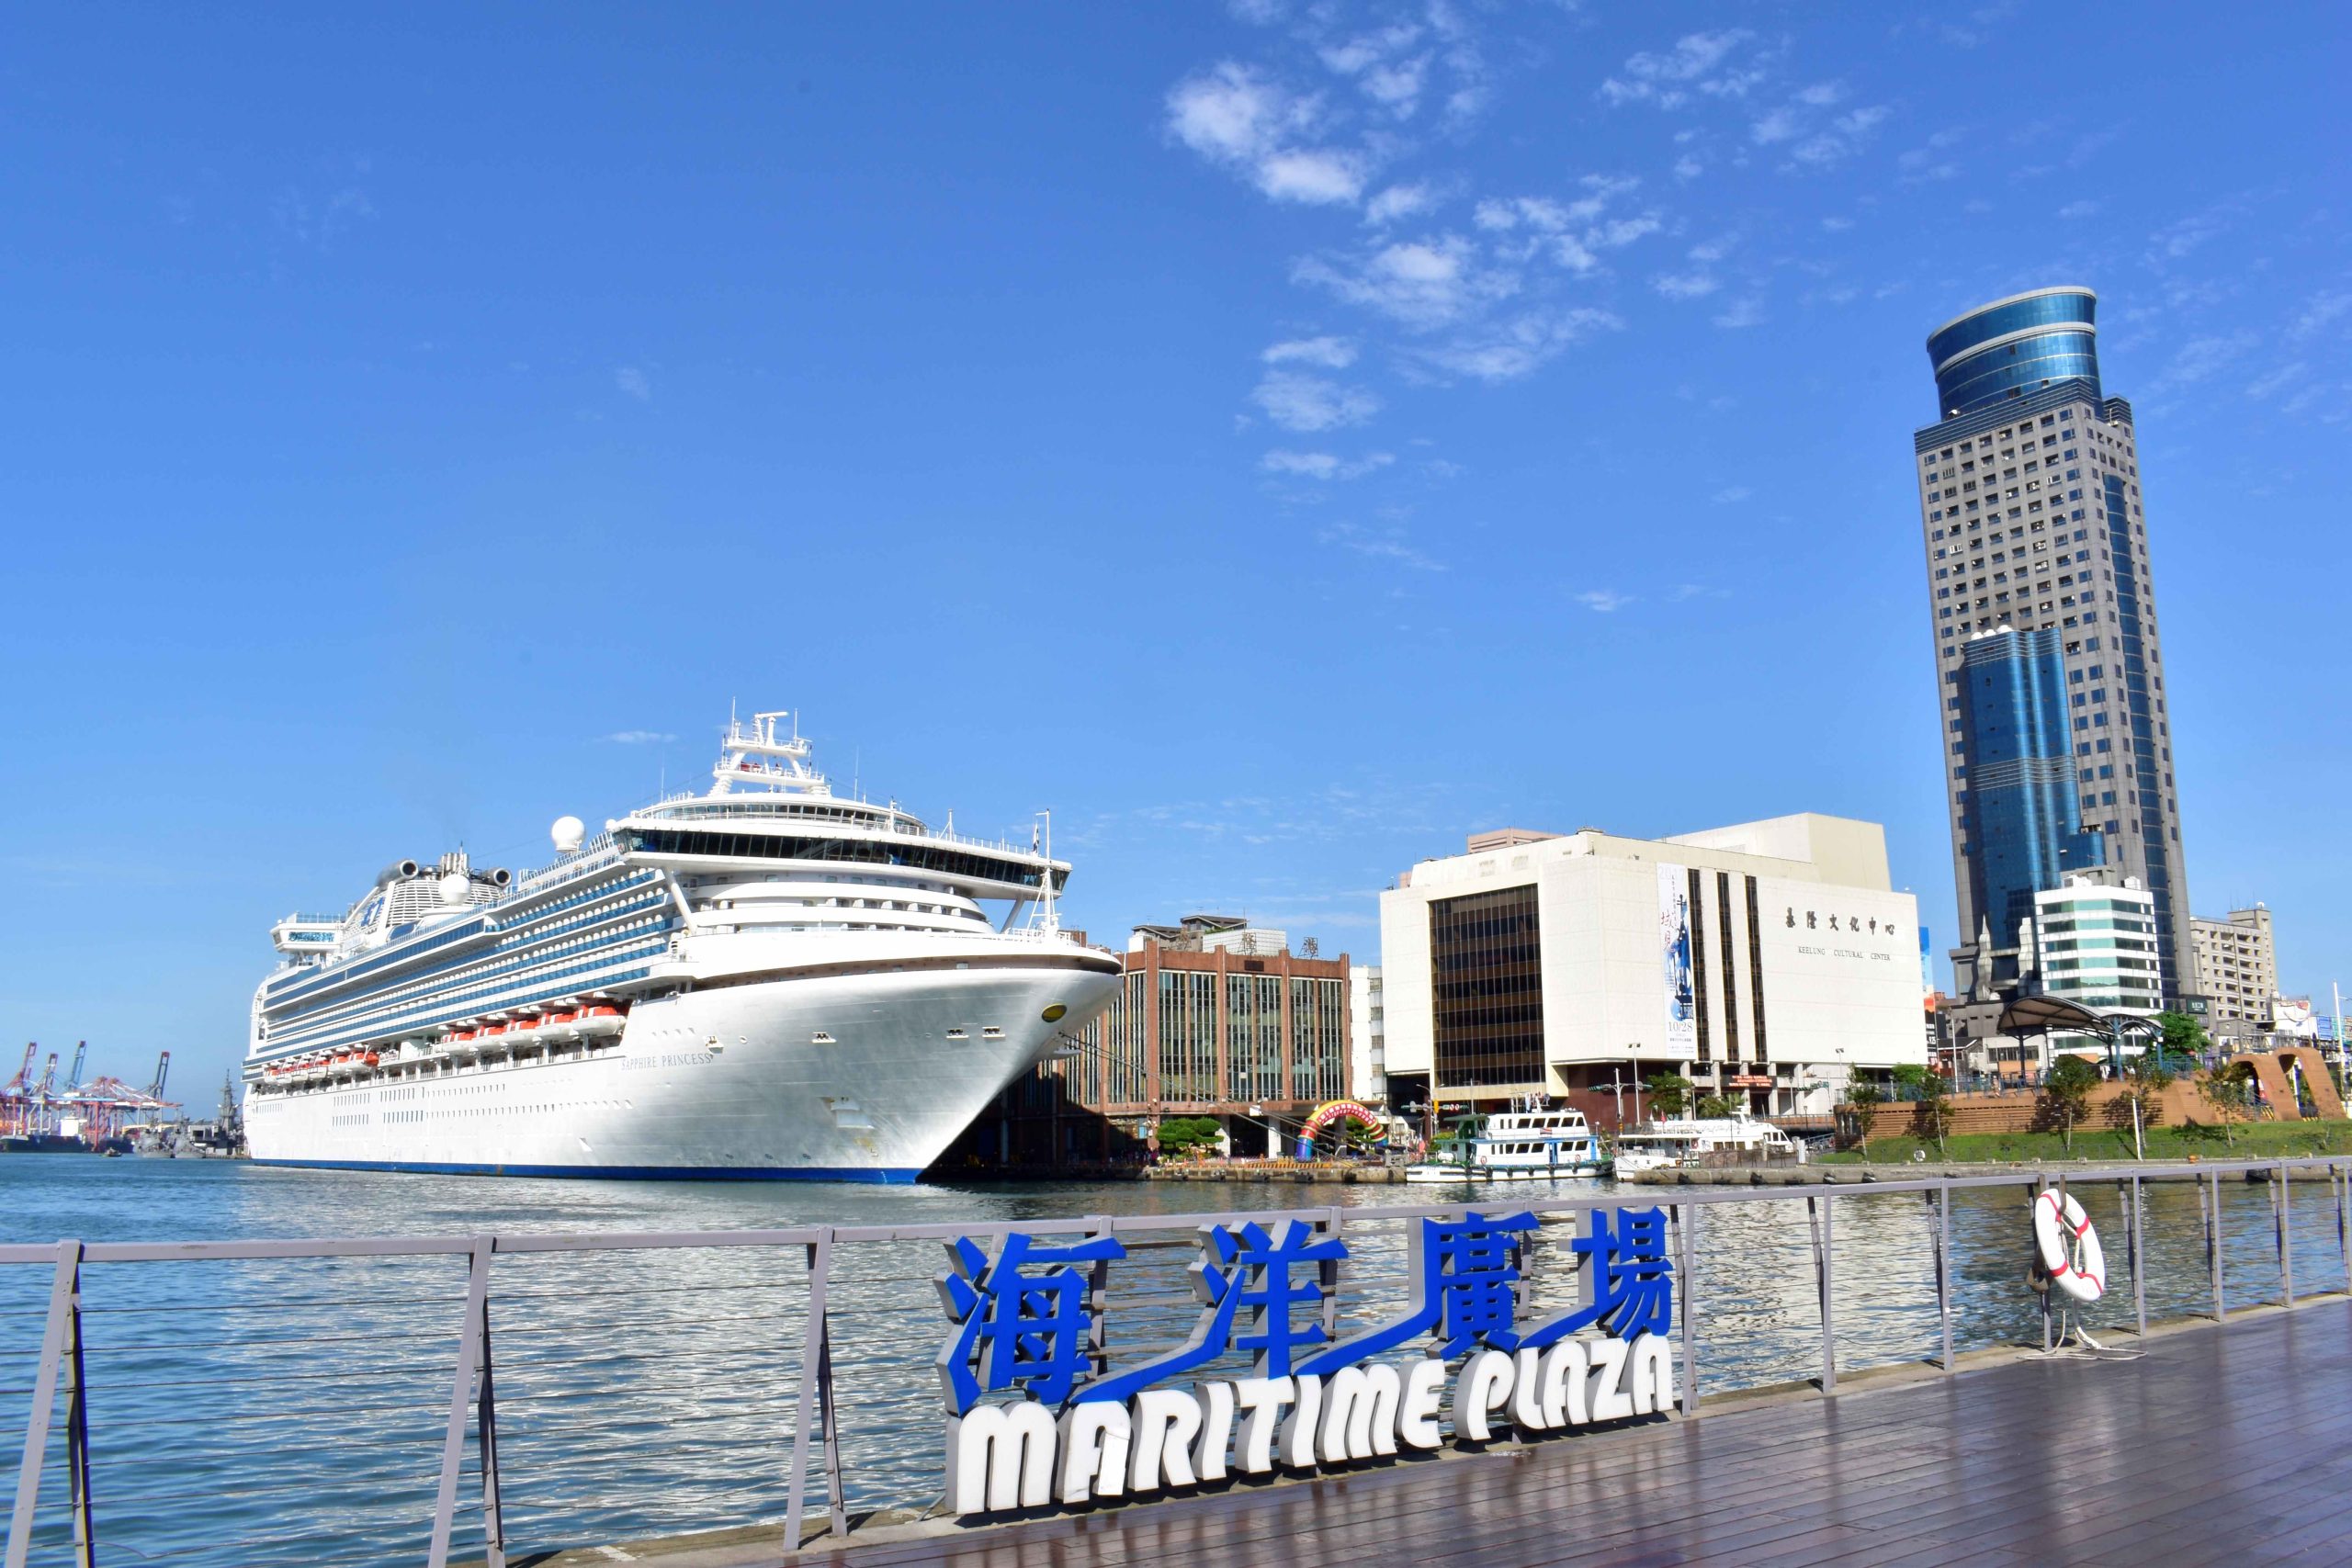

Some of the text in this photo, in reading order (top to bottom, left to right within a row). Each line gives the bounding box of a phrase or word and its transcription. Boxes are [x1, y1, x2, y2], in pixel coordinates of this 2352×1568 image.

[1785, 906, 1895, 936] 基隆文化中心
[1797, 945, 1891, 962] KEELUNG CULTURAL CENTER
[1668, 1021, 1693, 1033] 10/28
[621, 1053, 712, 1071] SAPPHIRE PRINCESS
[933, 1205, 1673, 1417] 海洋廣場
[946, 1332, 1674, 1515] MARITIME PLAZA
